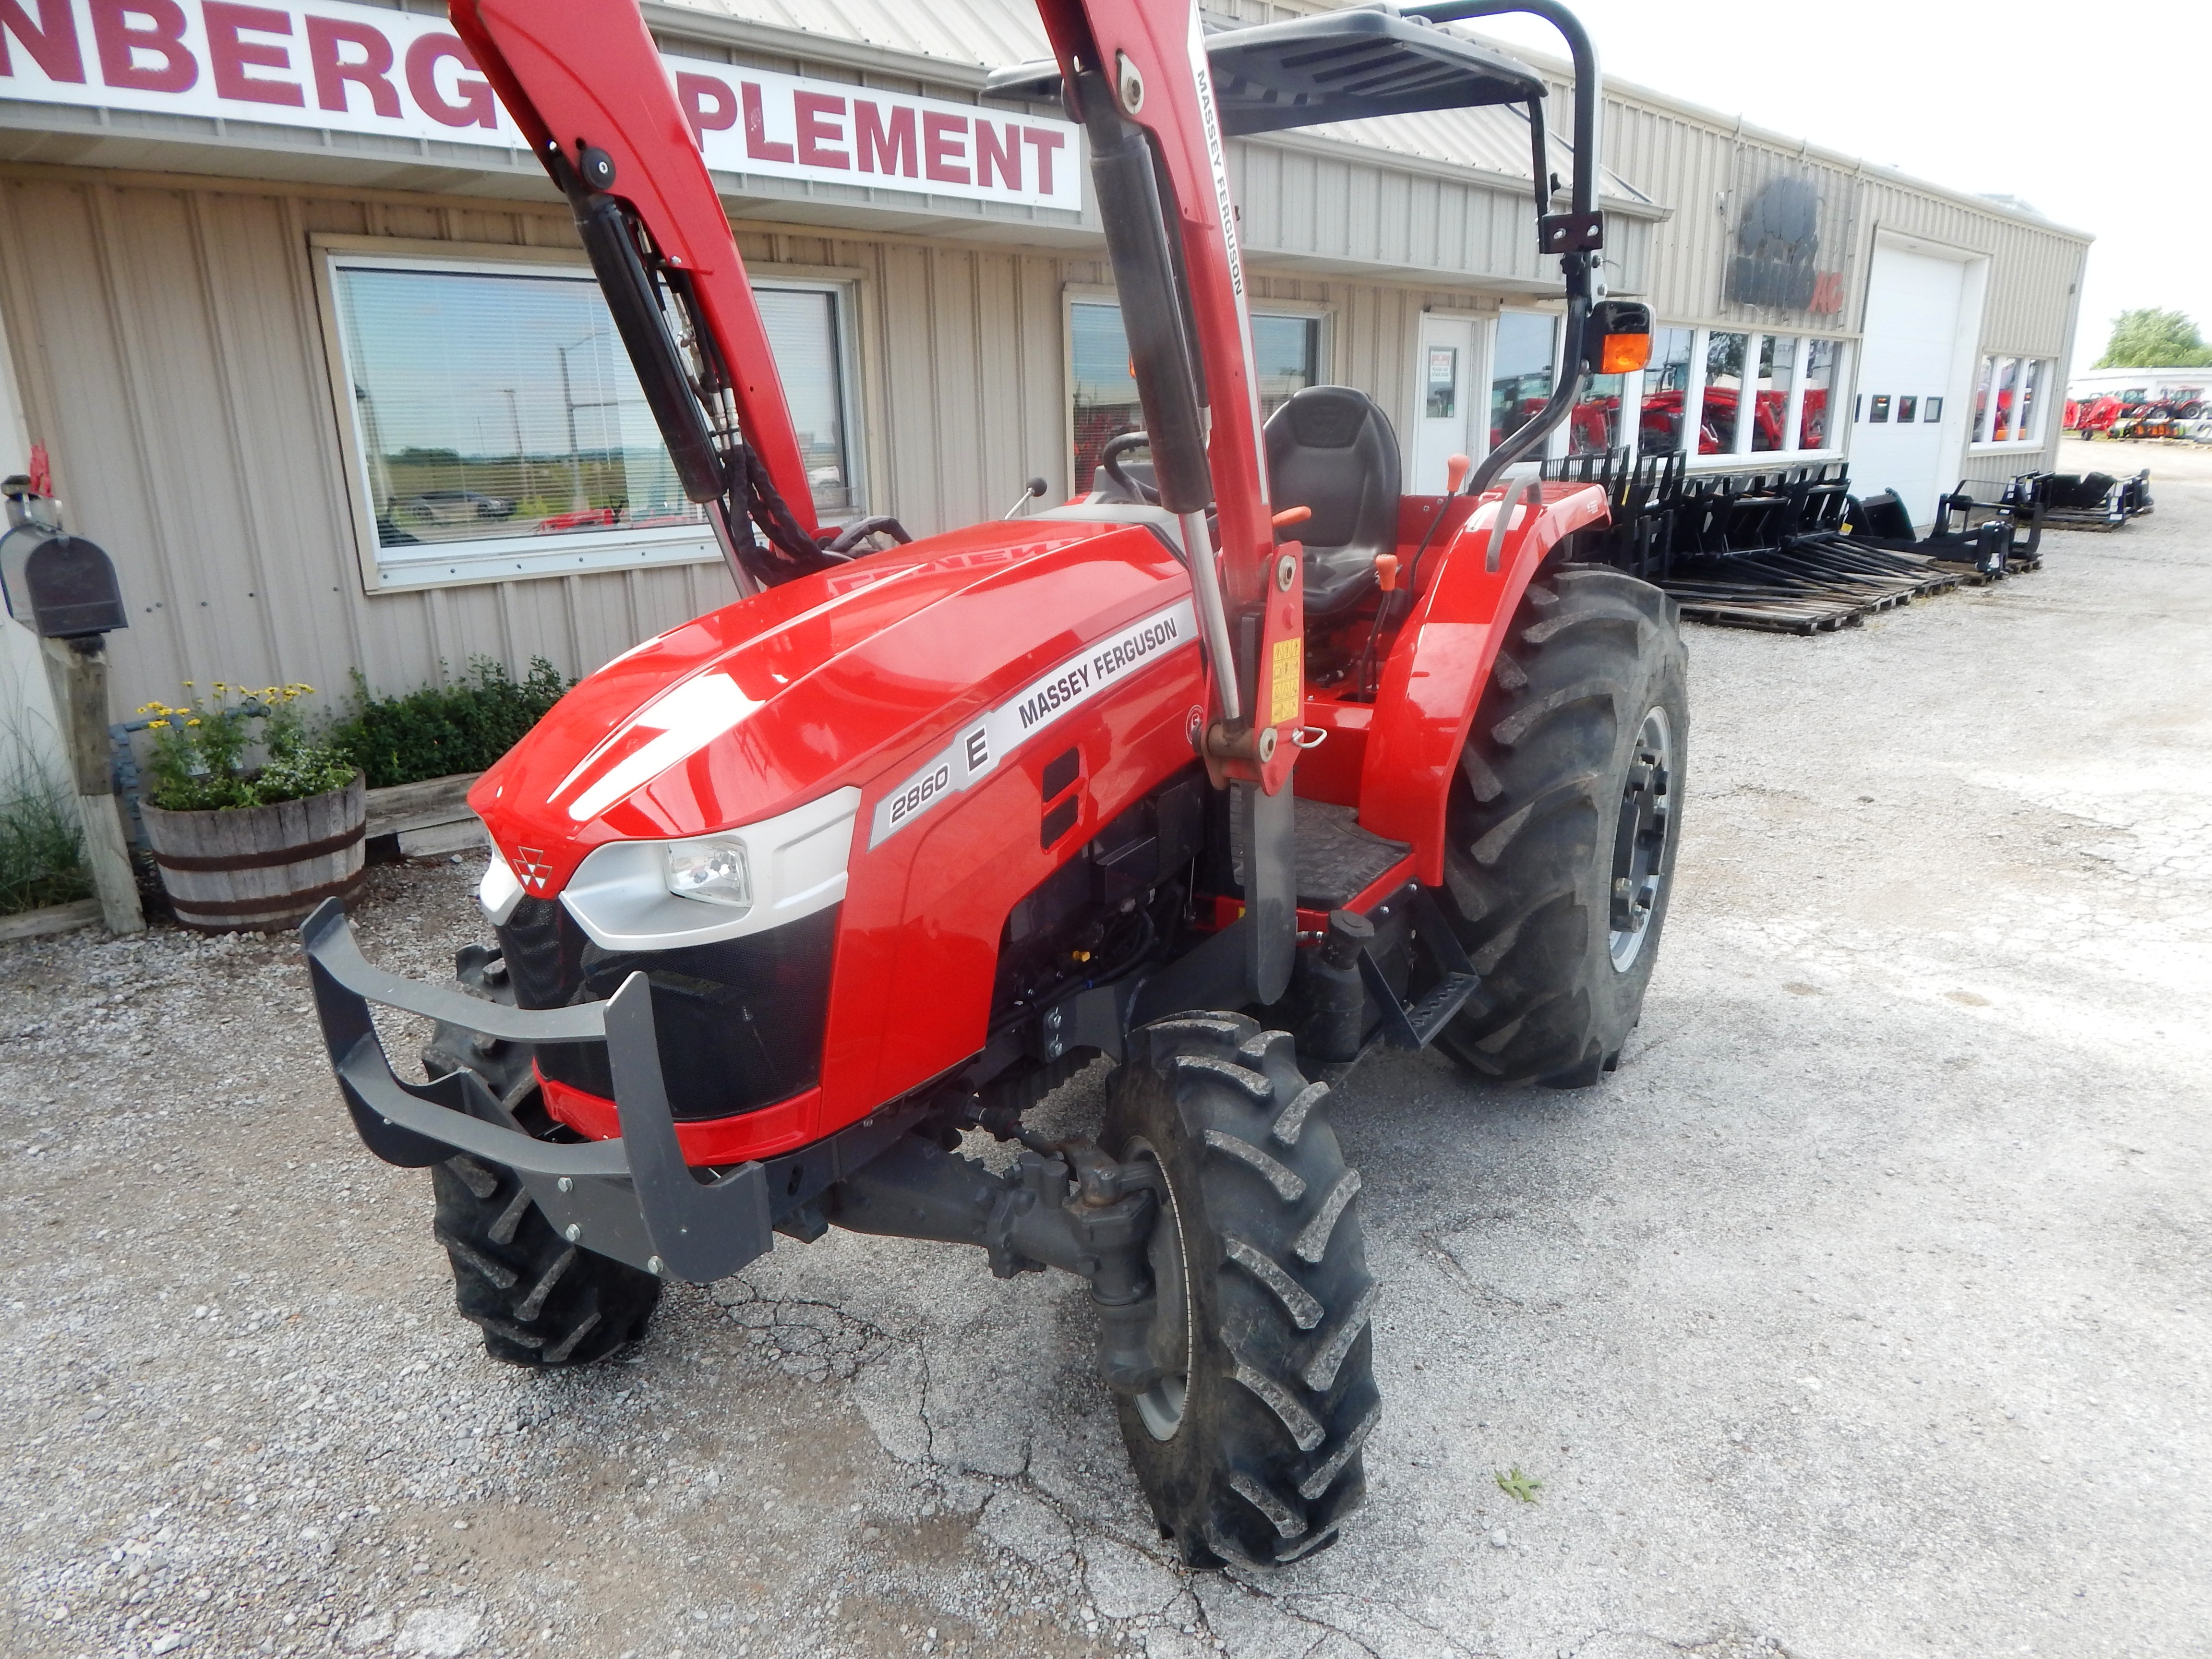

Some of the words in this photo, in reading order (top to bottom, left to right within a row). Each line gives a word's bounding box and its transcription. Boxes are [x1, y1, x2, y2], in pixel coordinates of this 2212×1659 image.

[0, 0, 498, 130] NBERG
[1197, 69, 1222, 168] MASSEY
[1217, 178, 1243, 296] FERGUSON
[891, 764, 949, 824] 2860
[966, 727, 989, 772] E
[1018, 663, 1090, 729] MASSEY
[1093, 617, 1178, 680] FERGUSON
